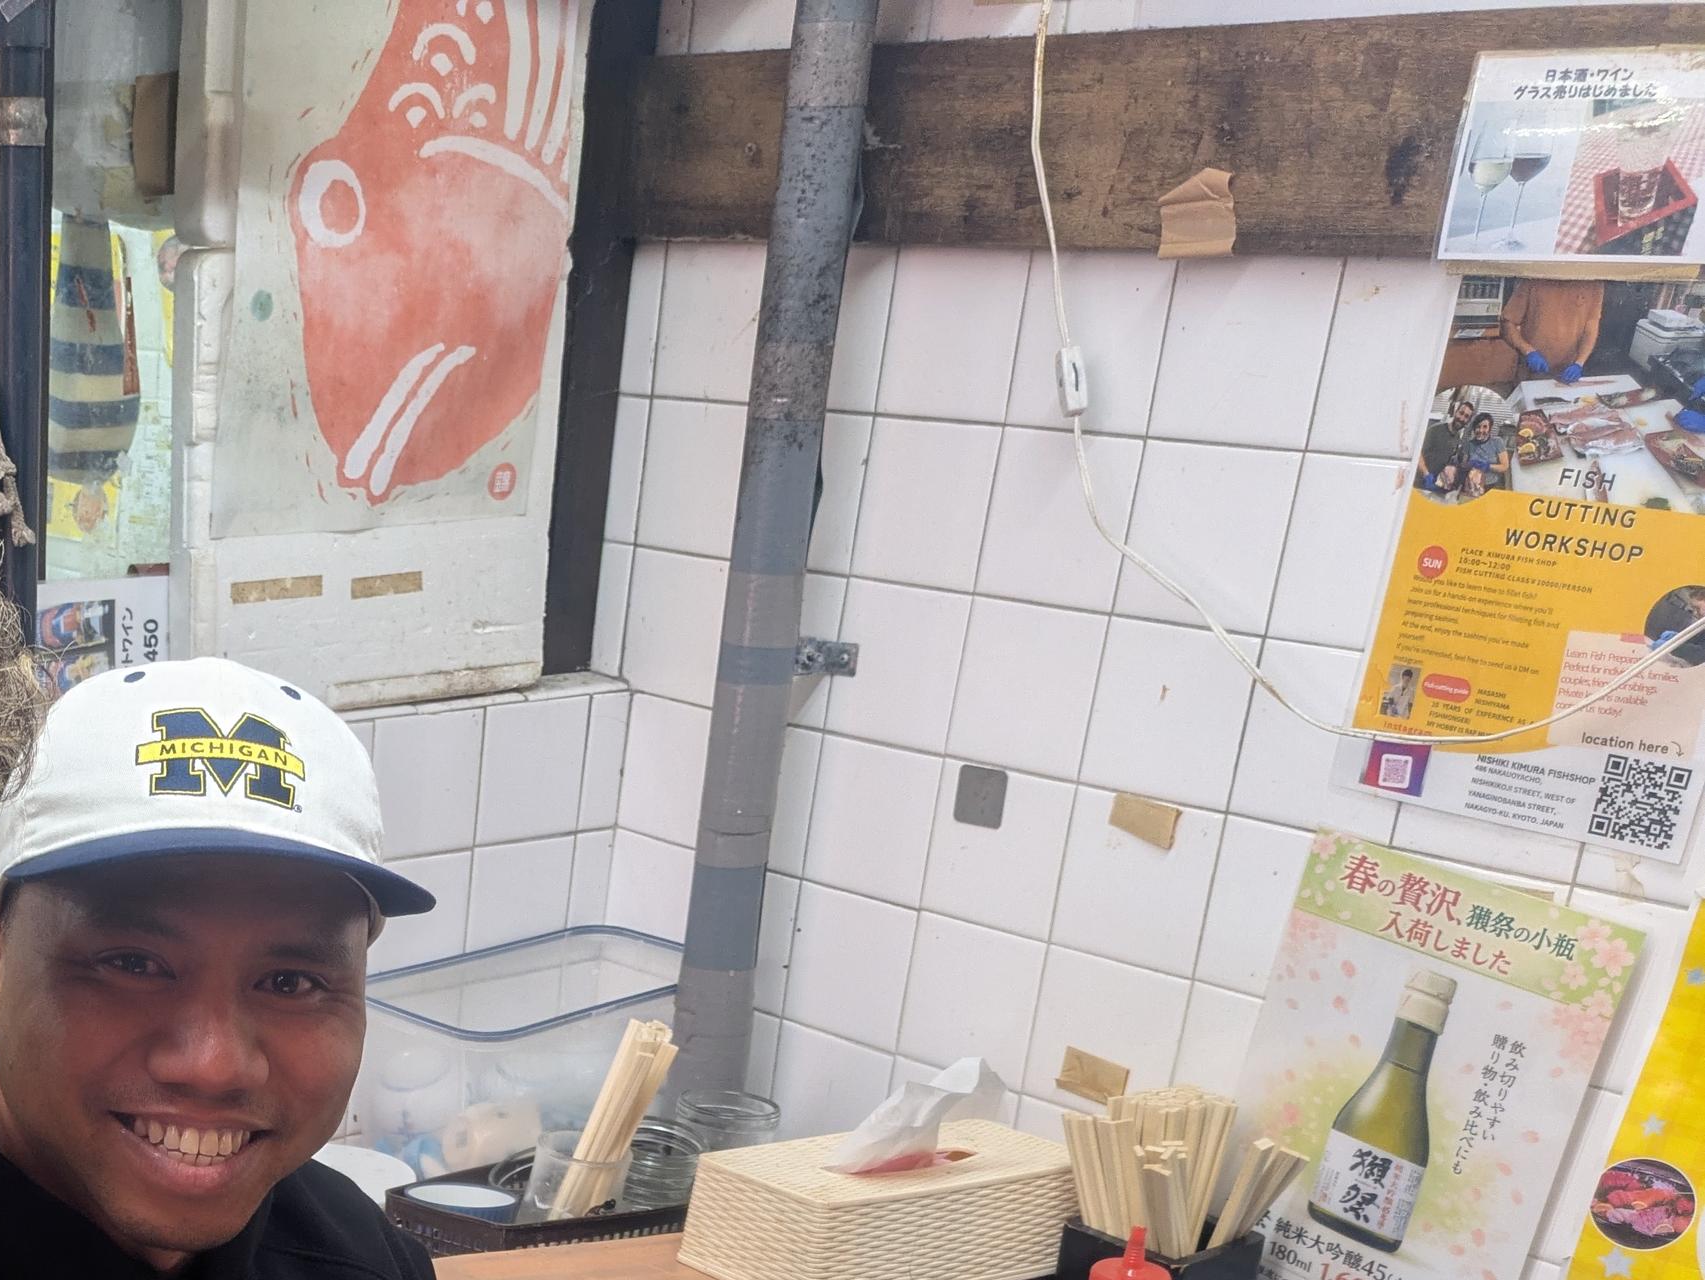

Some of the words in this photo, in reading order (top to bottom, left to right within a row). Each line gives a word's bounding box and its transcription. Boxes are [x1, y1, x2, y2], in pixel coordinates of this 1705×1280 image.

[1513, 83, 1657, 100] グラス売りはじめました
[1558, 468, 1616, 491] FISH
[1529, 498, 1636, 528] CUTTING
[1505, 528, 1644, 563] WORKSHOP
[1422, 557, 1443, 569] SUN
[1461, 548, 1483, 557] PLACE
[1486, 552, 1515, 561] KIMURA
[1516, 556, 1534, 565] FISH
[1536, 559, 1557, 567] SHOP
[1456, 566, 1472, 575] FISH
[1473, 570, 1506, 580] CUTTING
[1432, 579, 1445, 587] you
[1446, 579, 1458, 587] like
[1433, 588, 1441, 597] for
[1423, 600, 1461, 612] professional
[1434, 625, 1451, 636] enjoy
[1452, 628, 1463, 636] the
[1467, 655, 1479, 664] free
[1566, 649, 1587, 659] Learn
[1590, 651, 1606, 660] Fish
[1563, 662, 1590, 673] Perfect
[1591, 664, 1601, 673] for
[1558, 688, 1583, 698] Private
[1442, 703, 1461, 712] YEARS
[1464, 706, 1473, 715] OF
[1476, 709, 1514, 723] EXPERIENCE
[1581, 732, 1634, 750] location
[1638, 740, 1669, 754] here
[158, 741, 289, 768] MICHIGAN
[1477, 754, 1509, 768] NISHIKI
[1511, 759, 1545, 776] KIMURA
[1547, 769, 1596, 785] FISHSHOP
[1471, 777, 1513, 791] NISHIKIKOJI
[1544, 793, 1564, 802] WEST
[1468, 790, 1526, 808] YANAGINOBANBA
[1527, 803, 1557, 815] STREET,
[1540, 818, 1564, 829] JAPAN
[1378, 910, 1511, 976] 入荷しました
[1482, 1040, 1527, 1141] 飲み切りやすい
[1452, 1034, 1508, 1175] 贈り物・飲み比べにも
[1269, 1241, 1313, 1273] 180ml
